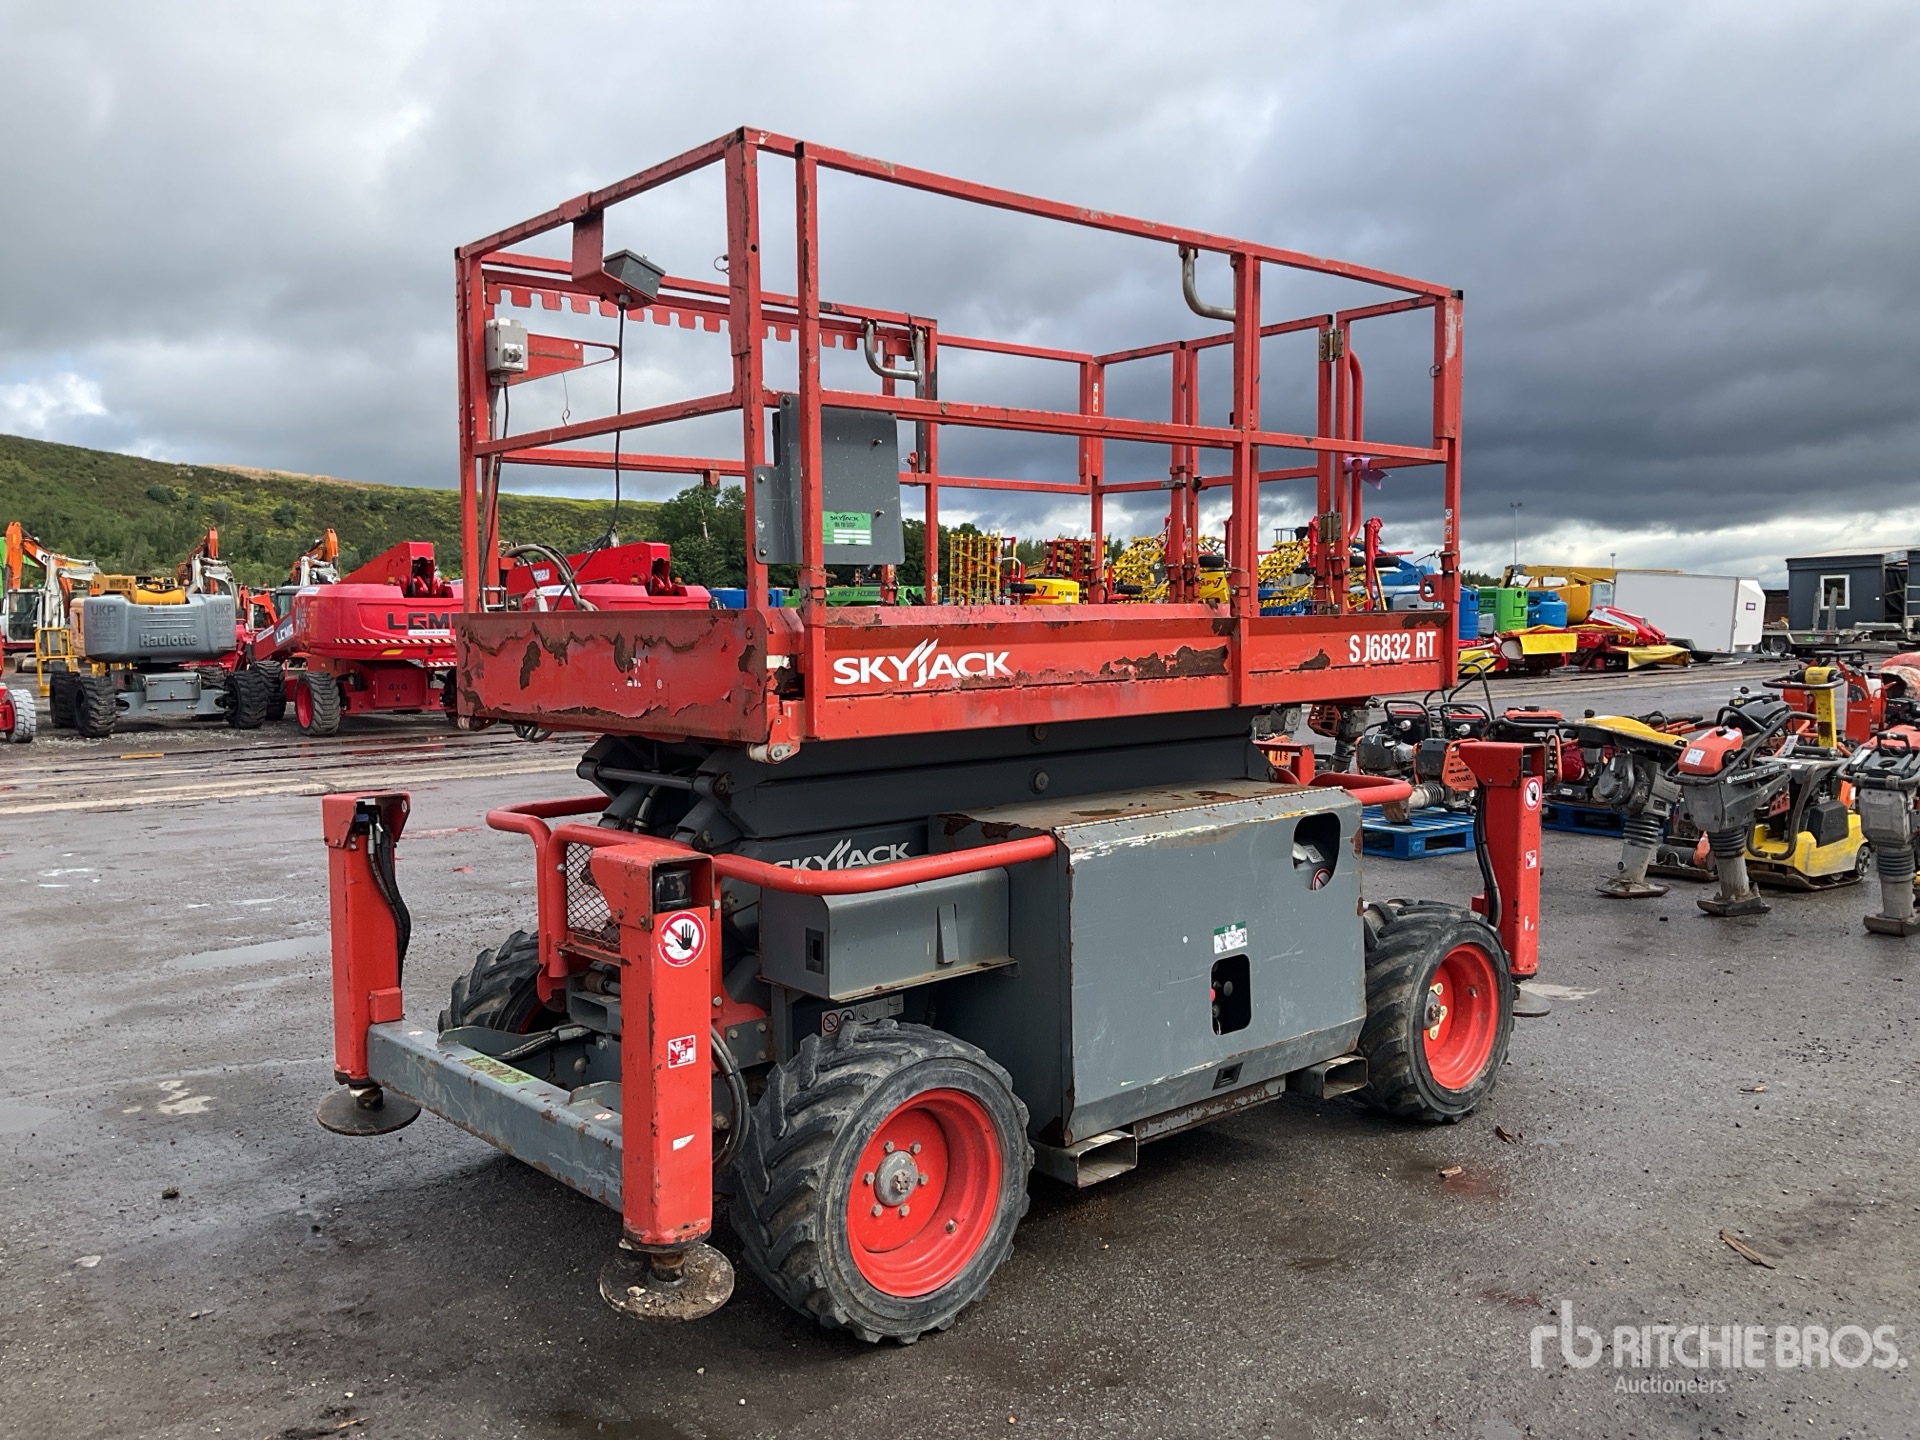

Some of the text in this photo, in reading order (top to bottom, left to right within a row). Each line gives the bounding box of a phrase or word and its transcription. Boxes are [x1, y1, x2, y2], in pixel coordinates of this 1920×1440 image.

[90, 604, 116, 616] UKP
[215, 603, 231, 615] UKP
[139, 632, 198, 648] Haulotte
[1349, 631, 1436, 663] SJ6832 RT
[833, 637, 1014, 688] SKYJACK
